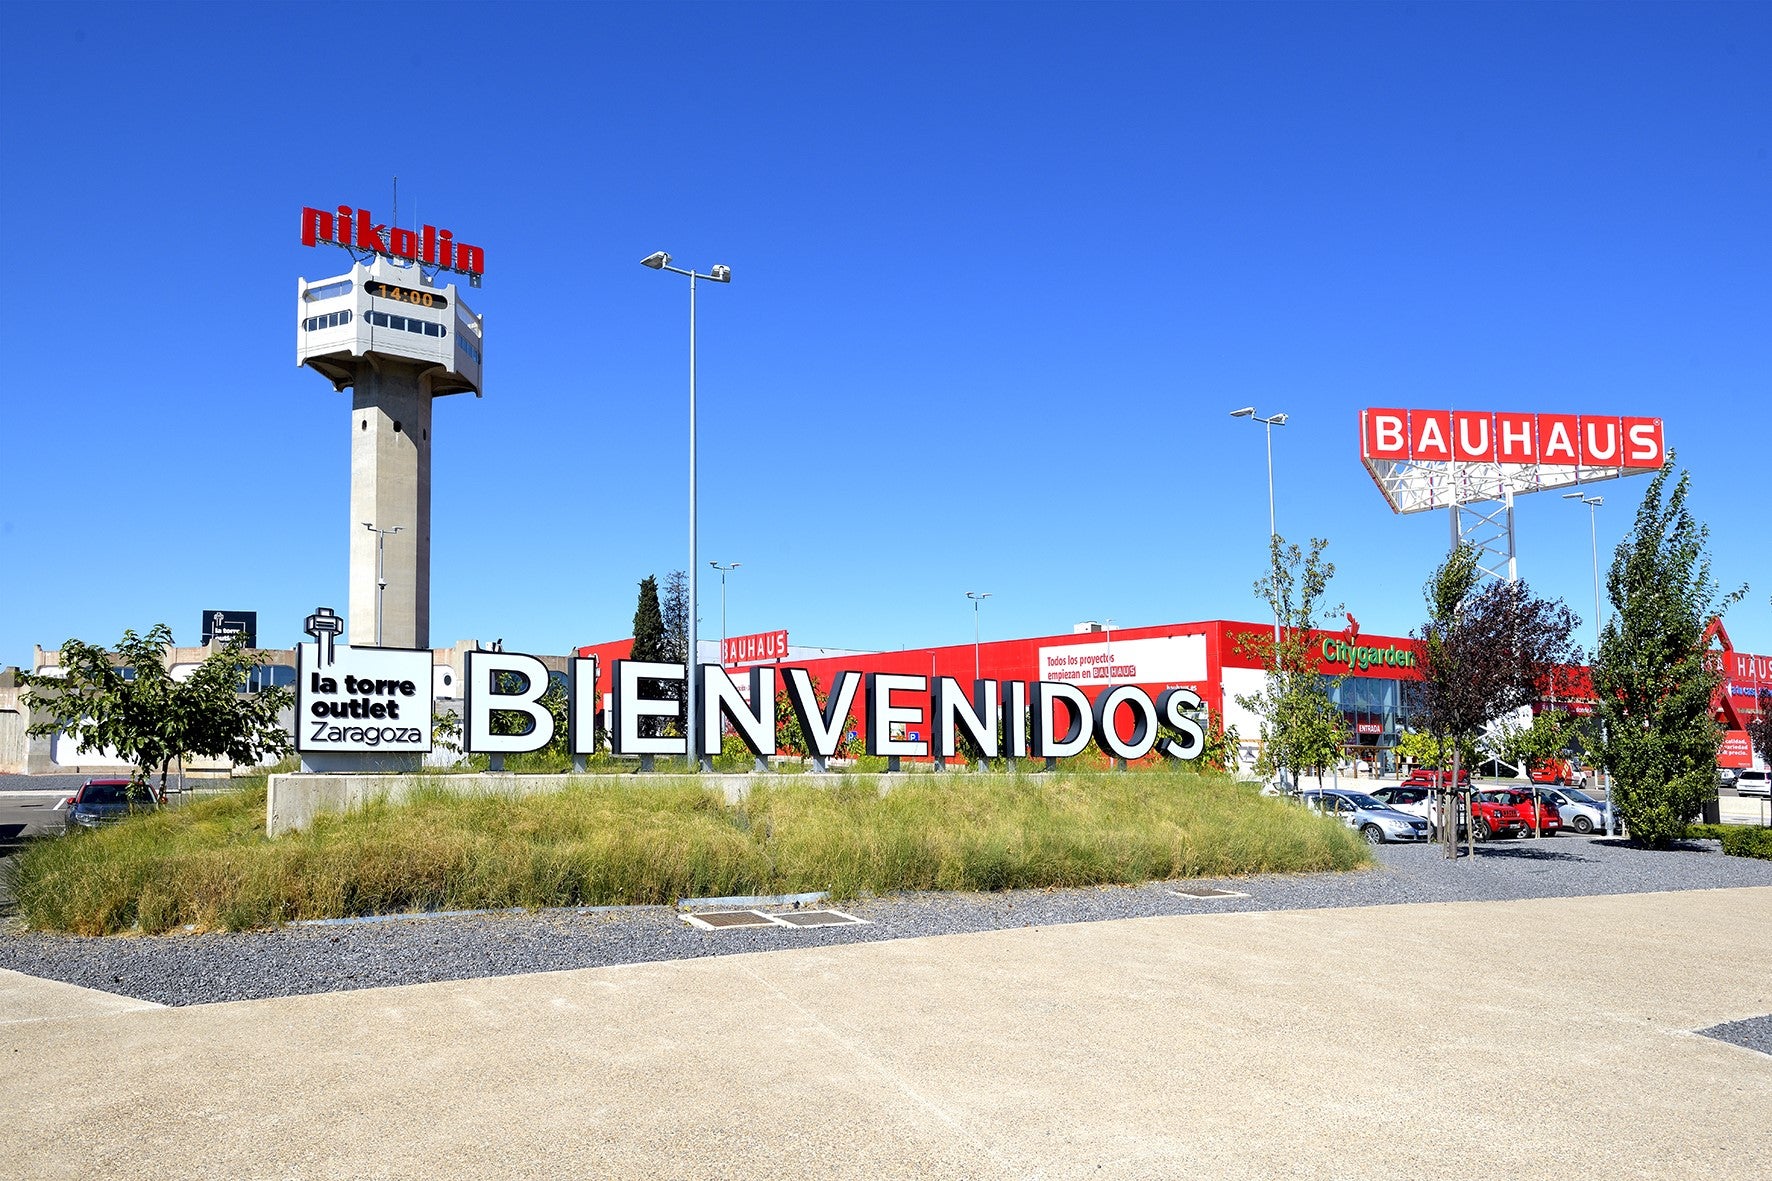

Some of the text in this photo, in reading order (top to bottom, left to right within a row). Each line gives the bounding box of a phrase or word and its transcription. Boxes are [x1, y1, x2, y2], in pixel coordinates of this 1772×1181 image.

[301, 205, 484, 274] pikolin
[378, 285, 433, 307] 14:00
[1375, 415, 1658, 460] BAUHAUS
[723, 634, 785, 659] BAUHAUS
[1322, 637, 1416, 669] Citygarden
[1047, 653, 1114, 666] Todos los proyectos
[311, 672, 416, 696] la torre
[1048, 669, 1080, 681] empiezan
[1082, 670, 1091, 678] en
[311, 698, 399, 719] outlet
[465, 650, 1204, 761] BIENVENIDOS
[310, 721, 422, 746] Zaragoza
